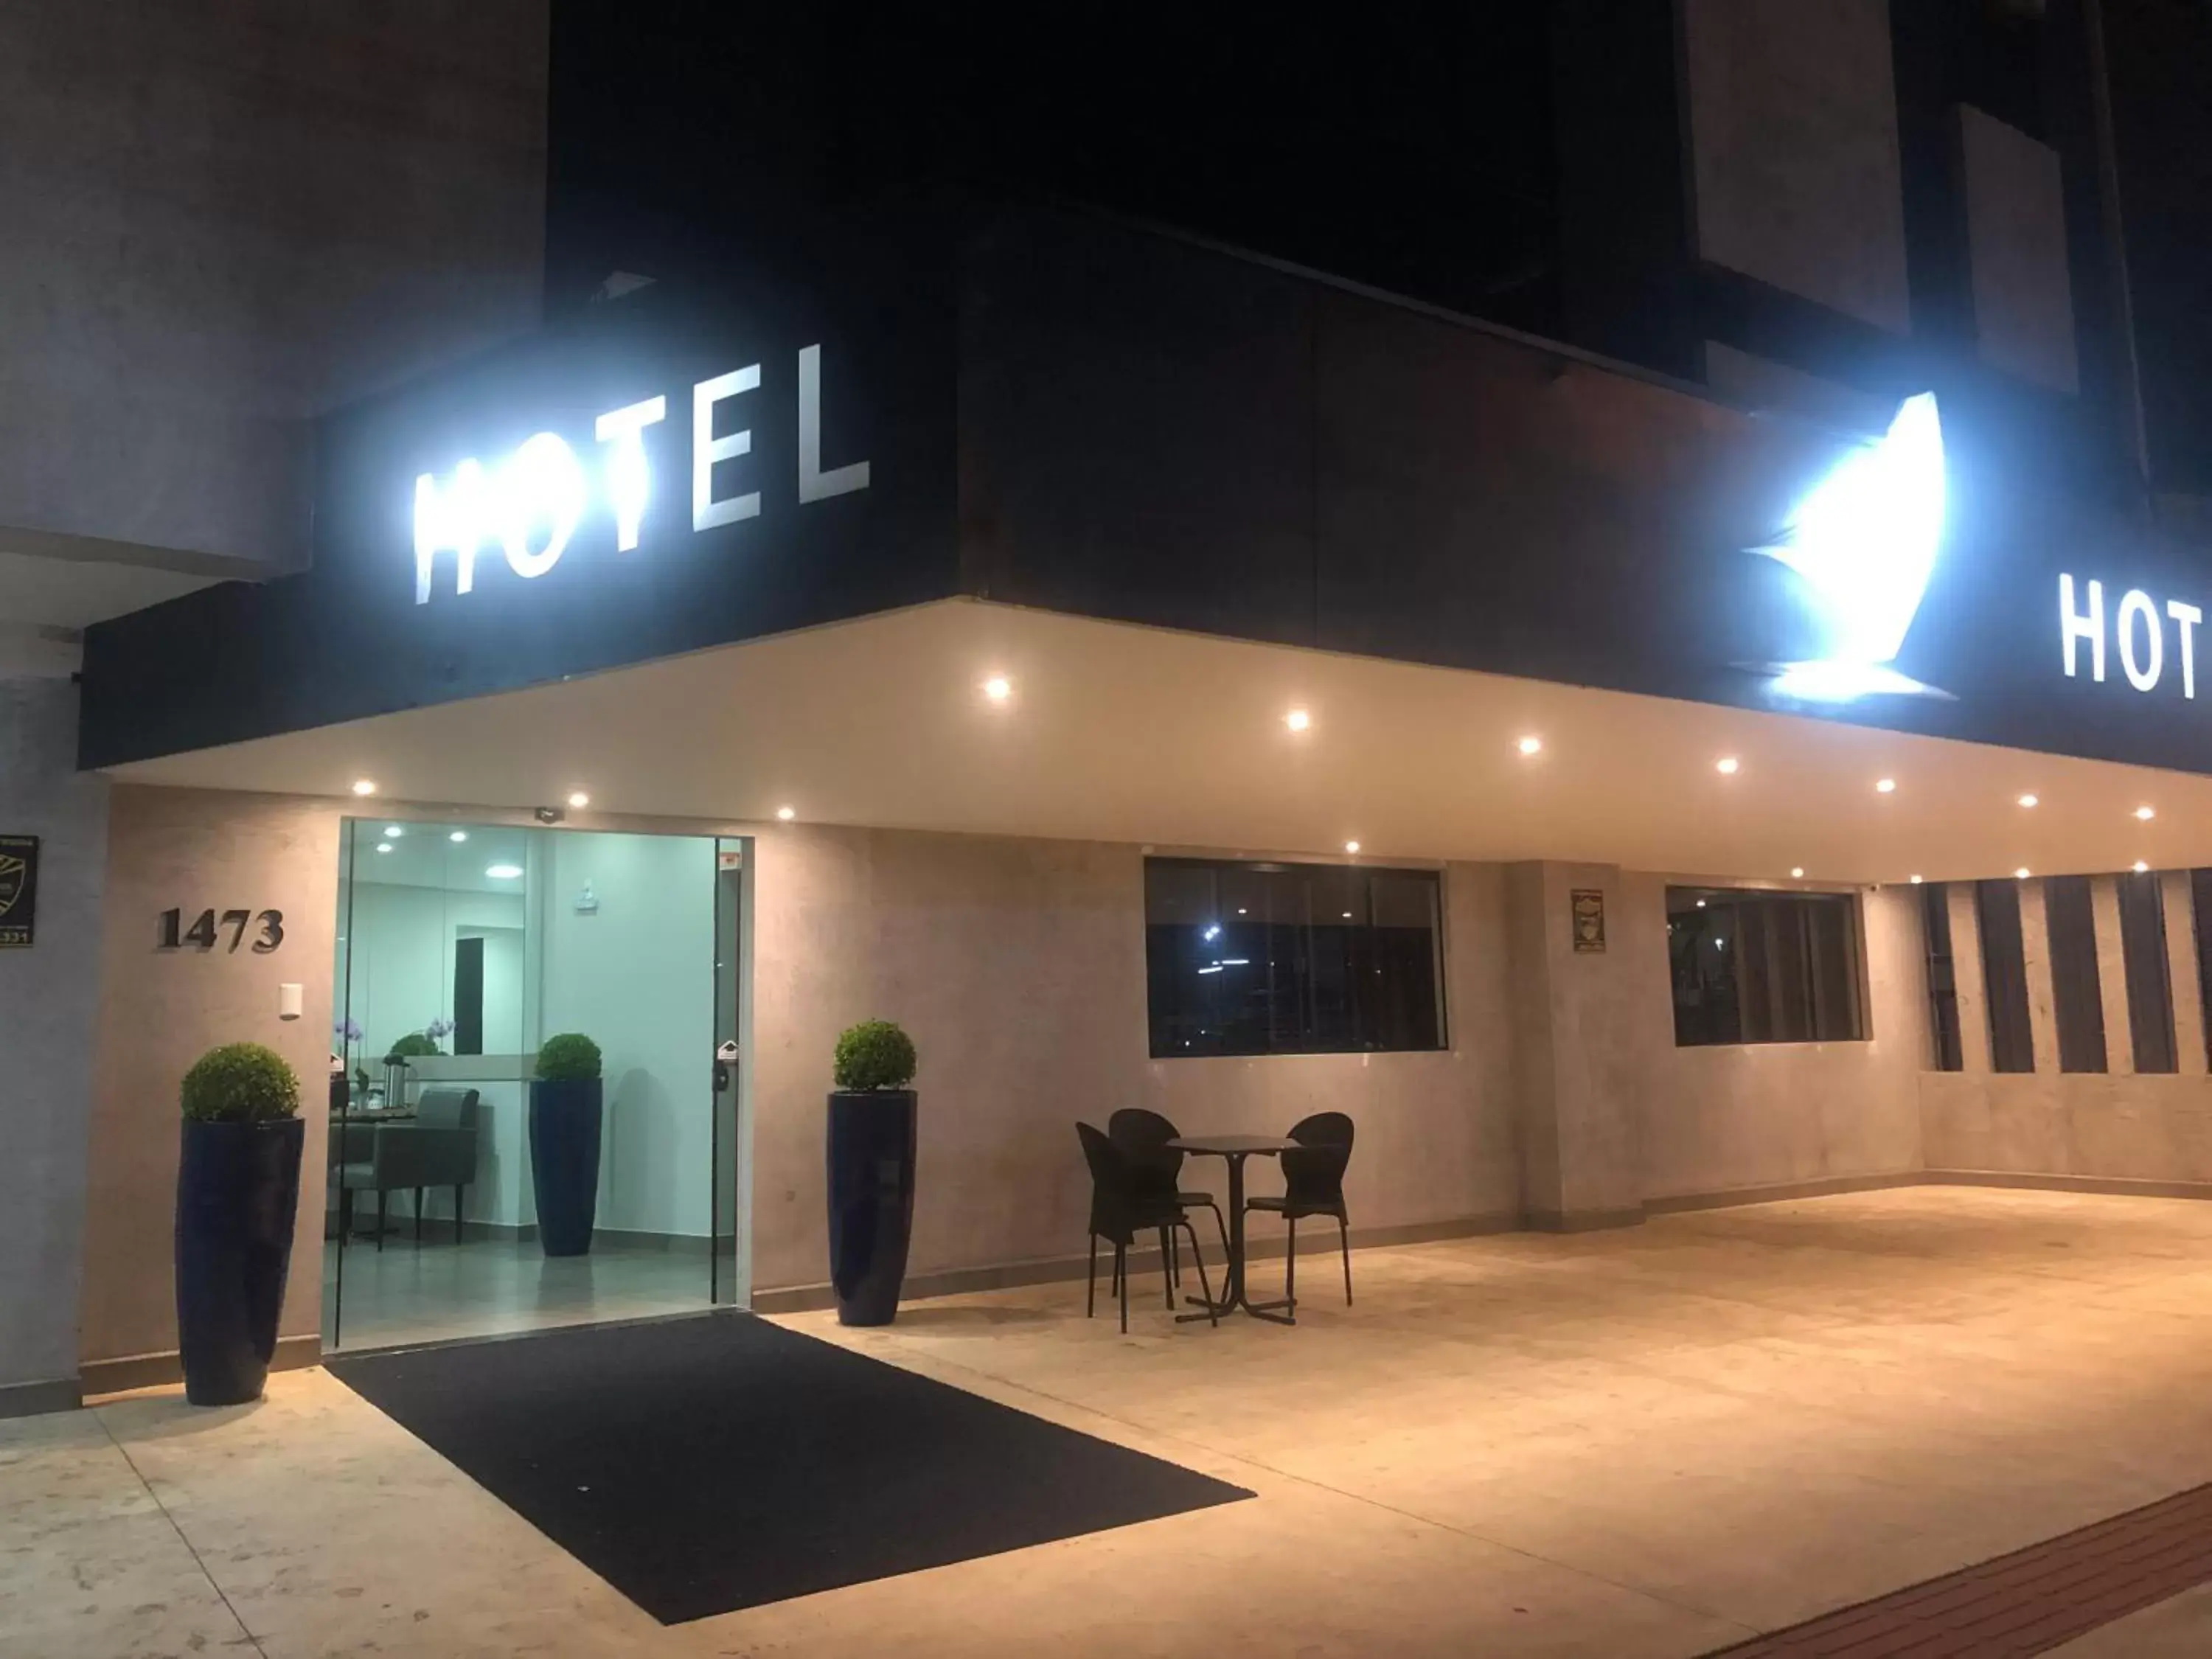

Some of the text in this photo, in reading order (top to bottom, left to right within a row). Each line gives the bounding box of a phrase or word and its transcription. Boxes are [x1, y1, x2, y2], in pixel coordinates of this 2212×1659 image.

[414, 344, 870, 605] HOTEL
[2059, 572, 2202, 700] HOT
[158, 908, 284, 954] 1473
